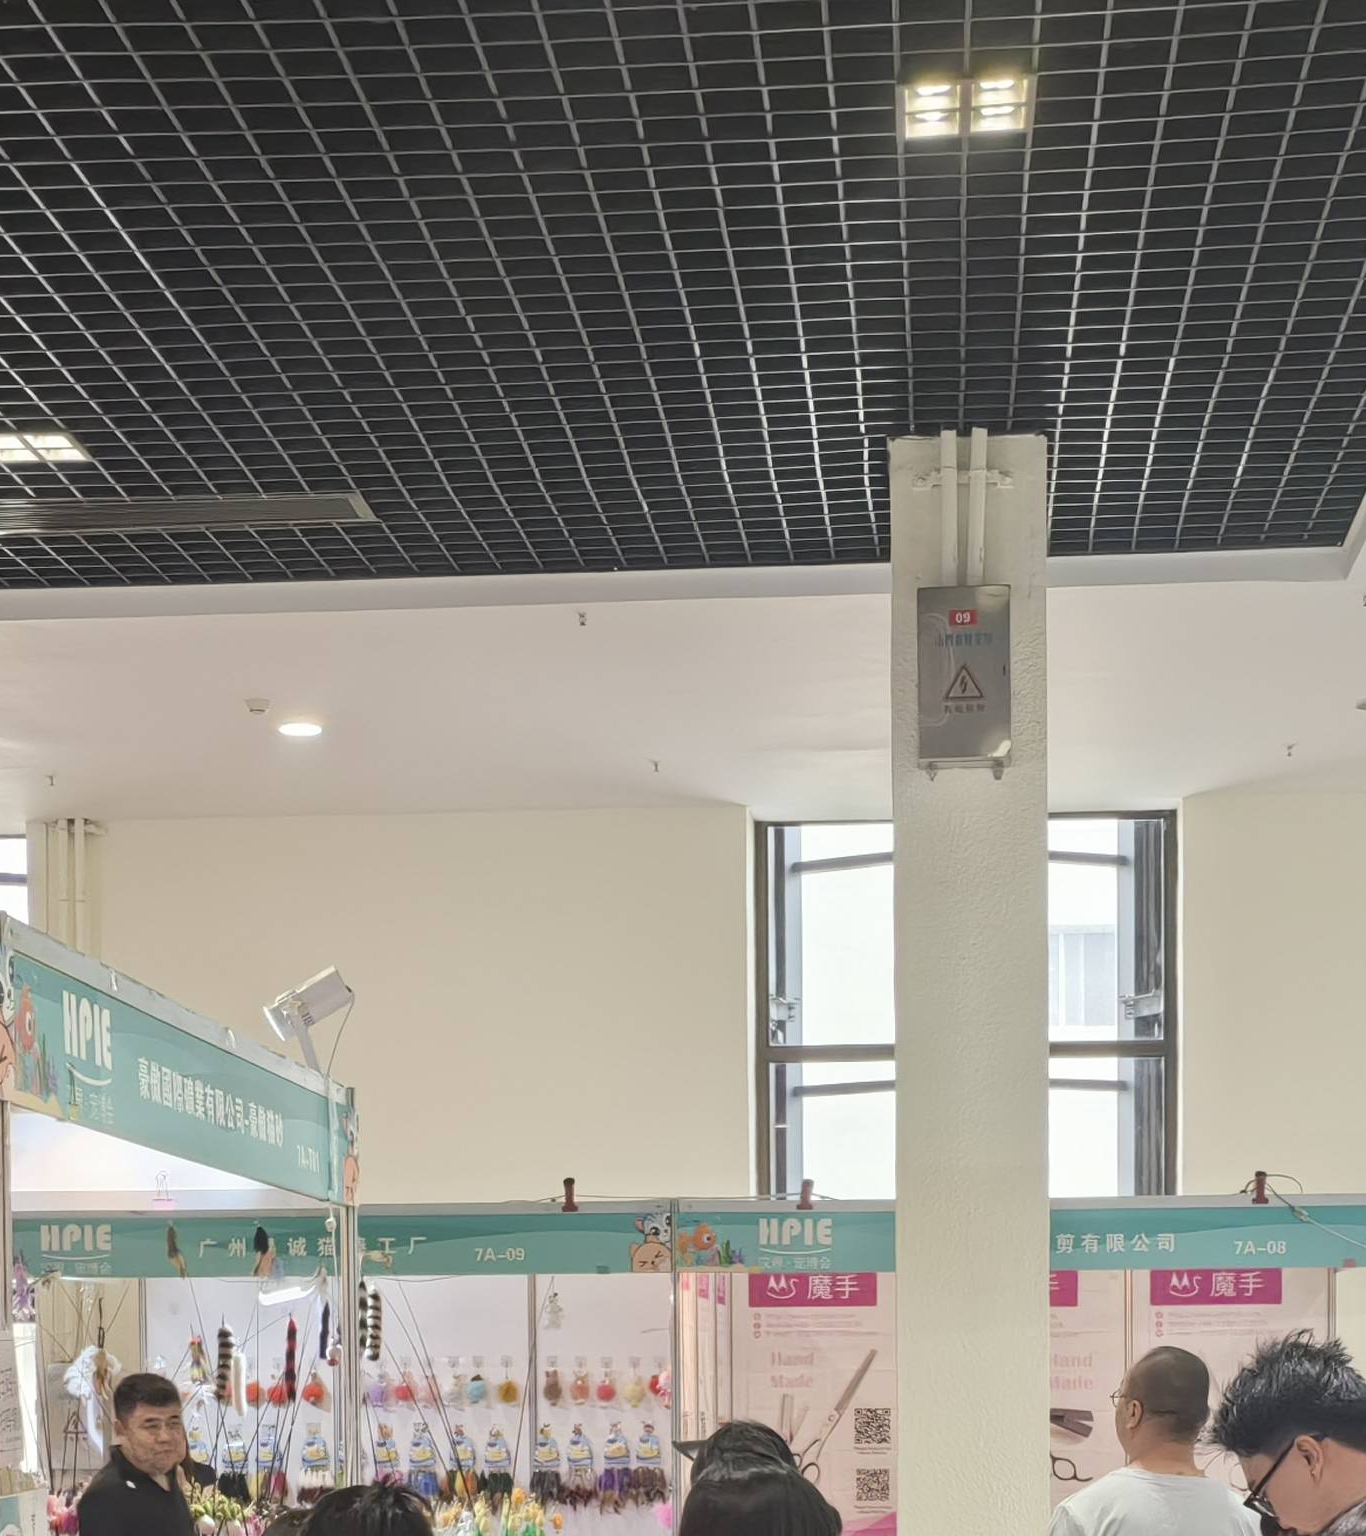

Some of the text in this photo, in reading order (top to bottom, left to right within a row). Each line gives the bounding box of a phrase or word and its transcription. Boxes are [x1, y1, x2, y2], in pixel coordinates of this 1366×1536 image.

[62, 990, 112, 1071] HPIE
[40, 1224, 111, 1252] HPIE
[758, 1217, 833, 1246] HPIE
[1055, 1233, 1287, 1255] 剪有限公司 7A-08
[474, 1248, 526, 1262] 7A-09
[807, 1275, 860, 1300] 魔手
[1209, 1271, 1265, 1297] 魔手
